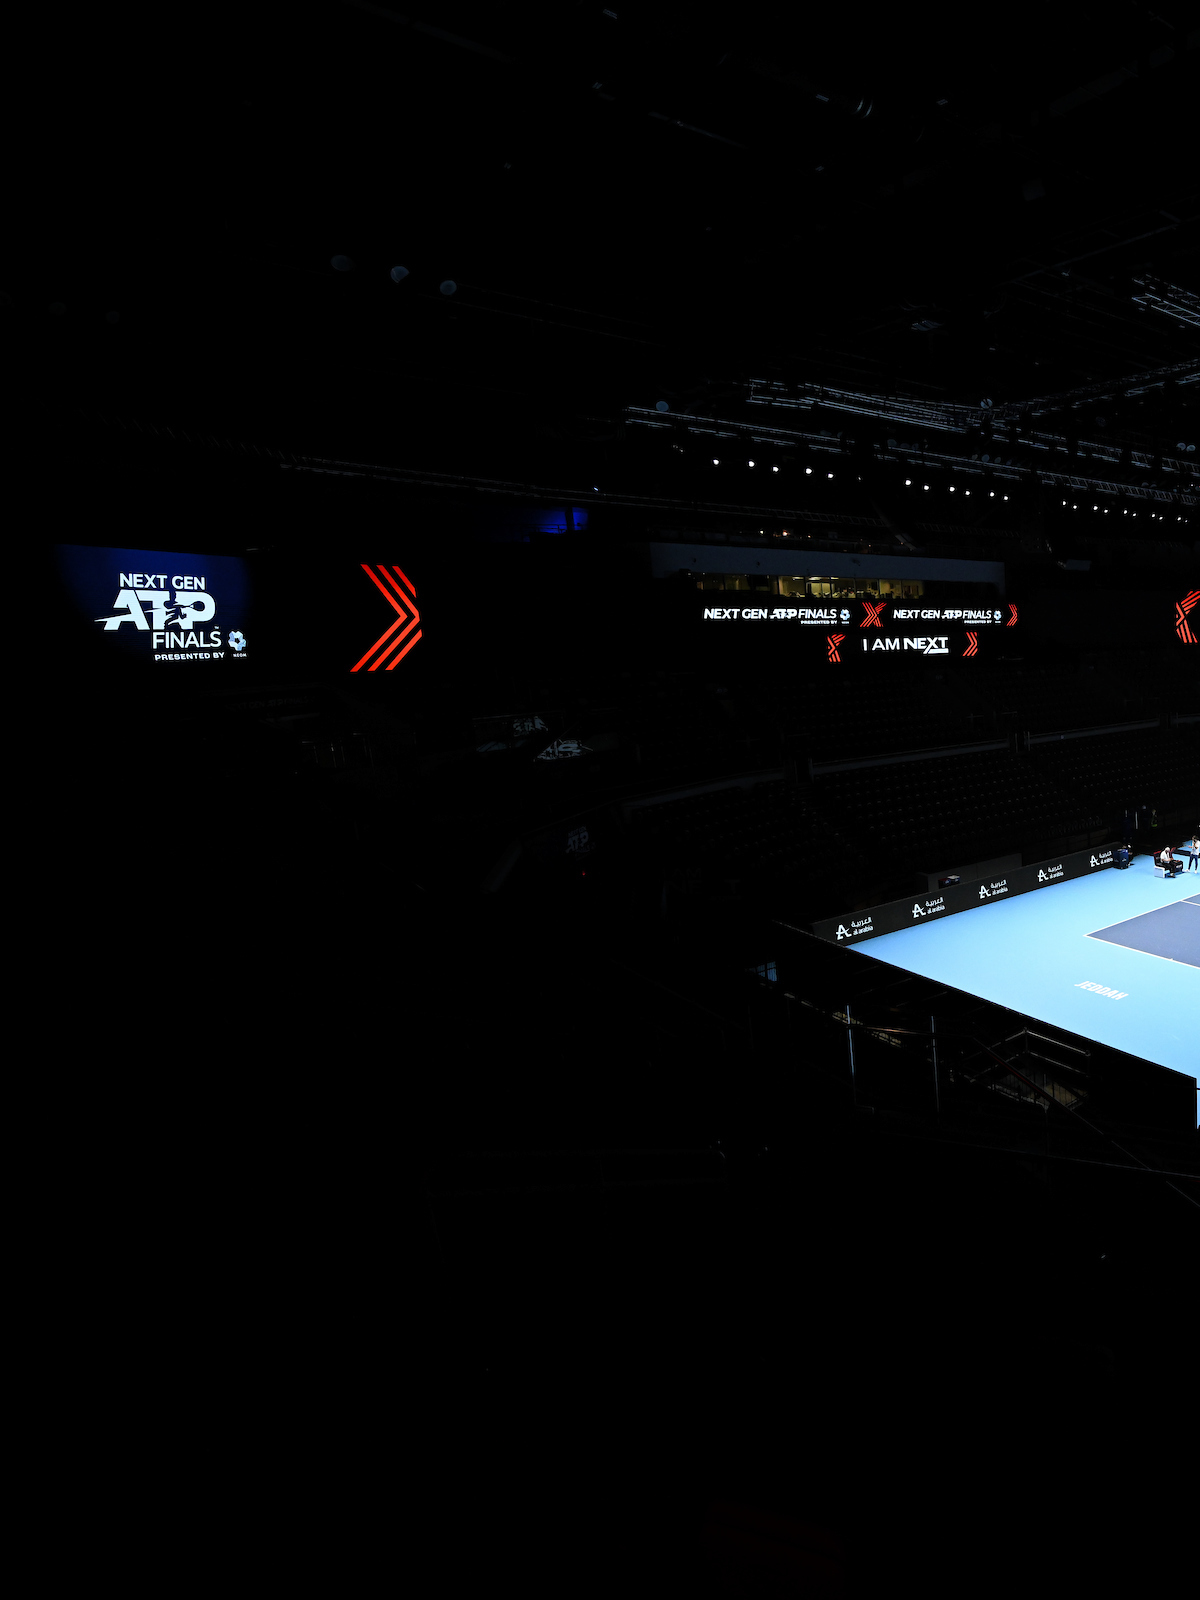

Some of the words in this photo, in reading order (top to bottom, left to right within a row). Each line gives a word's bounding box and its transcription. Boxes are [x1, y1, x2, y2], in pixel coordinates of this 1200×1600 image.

[119, 573, 167, 589] NEXT
[171, 576, 205, 590] GEN
[94, 589, 216, 630] ATP
[704, 608, 740, 619] NEXT
[741, 608, 768, 619] GEN
[769, 608, 797, 619] ATP
[798, 609, 837, 619] FINALS
[893, 609, 920, 619] NEXT
[921, 609, 940, 619] GEN
[941, 610, 962, 619] ATP
[963, 610, 992, 619] FINALS
[152, 631, 221, 649] FINALS
[863, 638, 867, 651] I
[872, 638, 900, 650] AM
[903, 637, 949, 654] NEXT
[154, 652, 210, 661] PRESENTED
[932, 904, 946, 913] arabia
[859, 925, 874, 934] arabia
[1074, 981, 1129, 1000] JEDDAH
